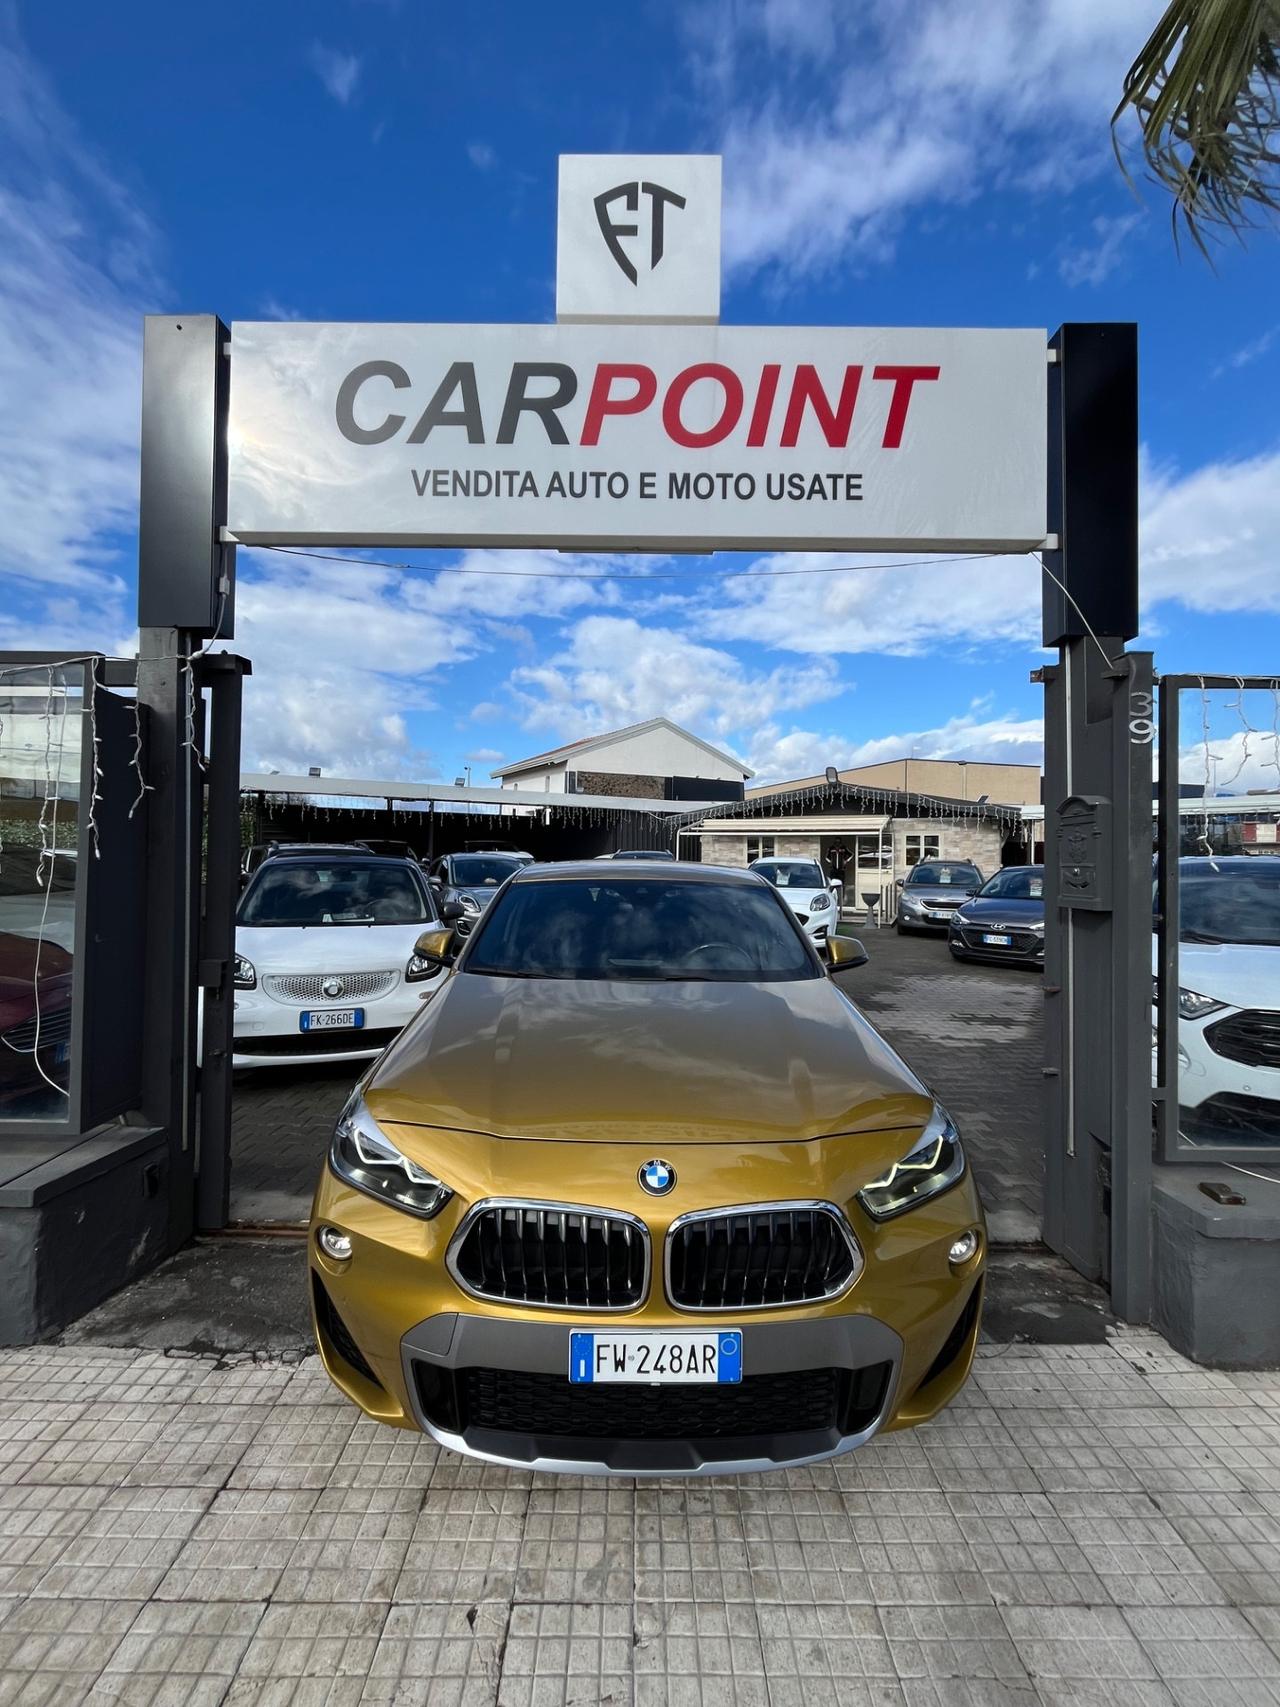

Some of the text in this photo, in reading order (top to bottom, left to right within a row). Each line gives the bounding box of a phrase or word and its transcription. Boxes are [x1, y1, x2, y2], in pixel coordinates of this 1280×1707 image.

[335, 359, 941, 449] CARPOINT
[411, 469, 863, 501] VENDITA AUTO E MOTO USATE
